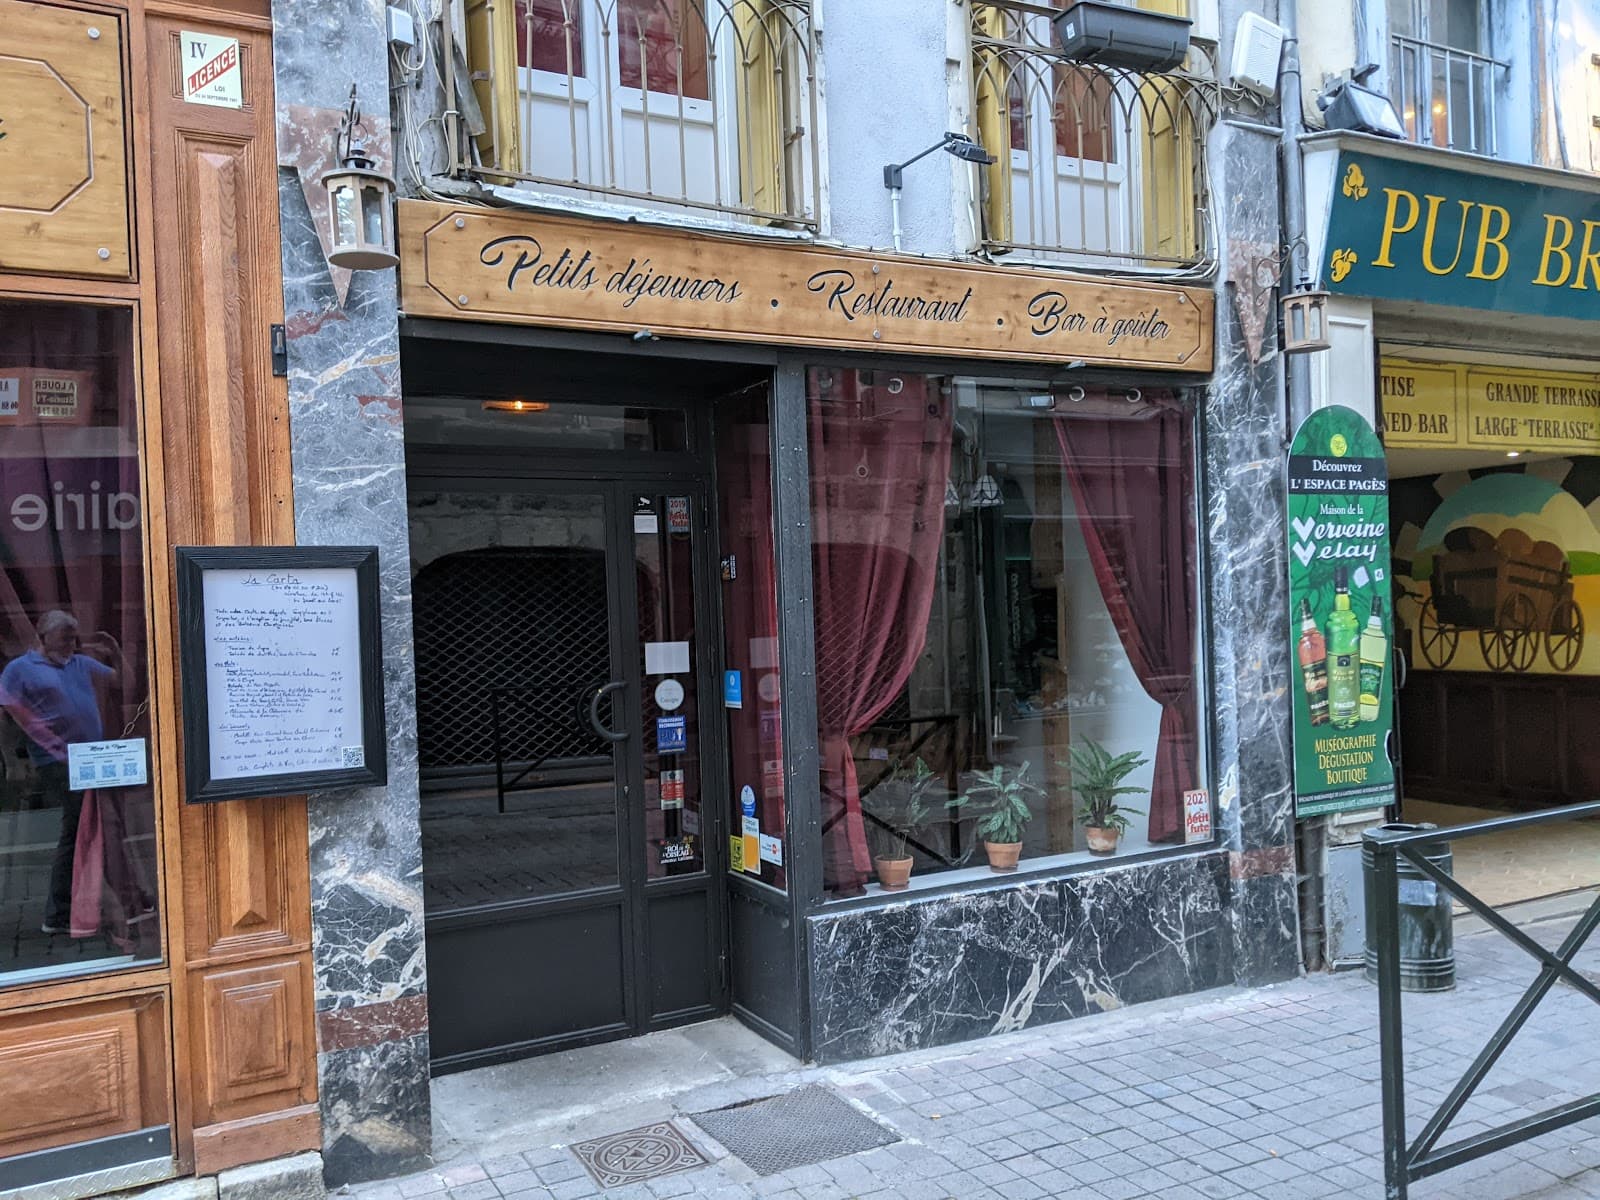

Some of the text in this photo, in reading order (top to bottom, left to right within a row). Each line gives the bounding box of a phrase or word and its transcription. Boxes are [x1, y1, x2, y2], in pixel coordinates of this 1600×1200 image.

[190, 41, 207, 59] IV
[189, 46, 236, 95] LICENCE
[1371, 187, 1511, 281] PUB
[480, 235, 1172, 346] Petits déjeuners Restaurant Bar à goûter
[1486, 382, 1540, 404] GRANDE
[1416, 413, 1449, 434] BAR
[1474, 415, 1518, 437] LARGE
[1312, 459, 1362, 472] Découvrez
[1349, 477, 1386, 491] PAGÈS
[1320, 503, 1364, 515] Maison de la
[1291, 516, 1385, 542] Verveine
[1292, 541, 1378, 567] Velay
[1315, 734, 1377, 754] MUSÉOGRAPHIE
[1319, 750, 1373, 770] DÉGUSTATION
[1327, 767, 1367, 785] BOUTIQUE
[1186, 792, 1207, 806] 2021
